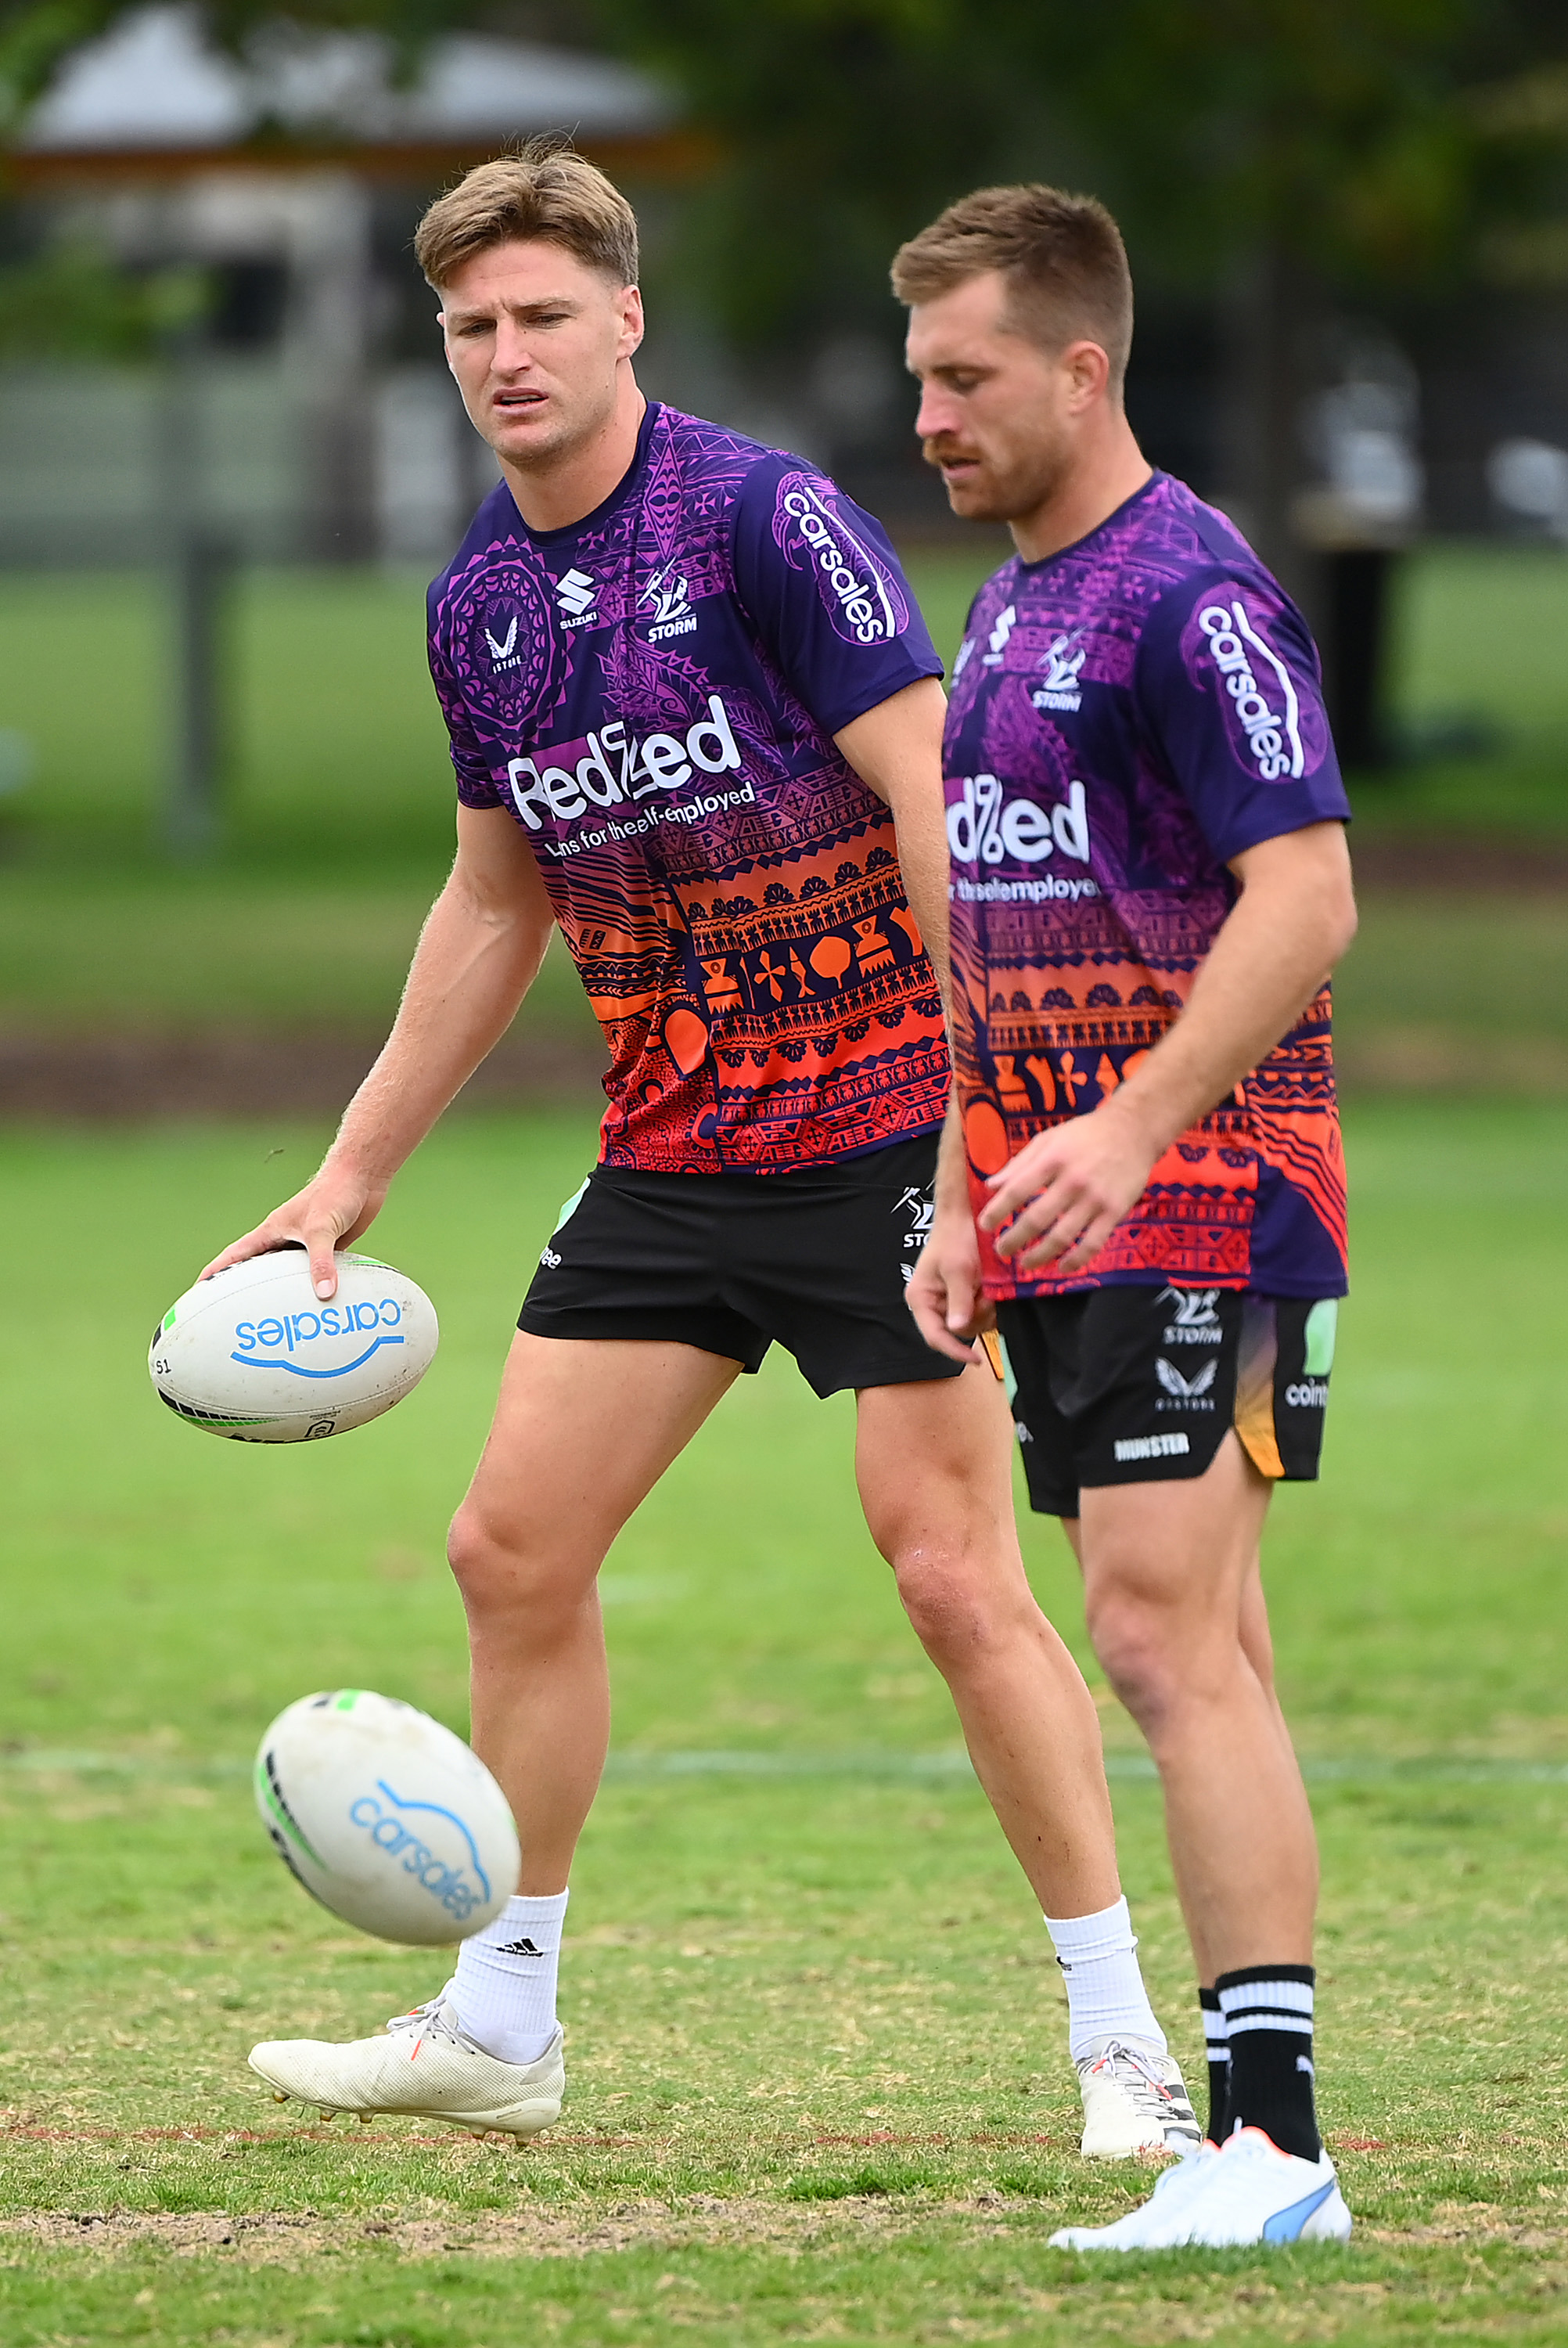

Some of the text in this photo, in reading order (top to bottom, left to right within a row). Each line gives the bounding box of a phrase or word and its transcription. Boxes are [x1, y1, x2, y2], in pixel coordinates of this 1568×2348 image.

[783, 492, 883, 643] carsales
[559, 611, 598, 630] SUZUKI
[648, 617, 697, 643] STORM
[1032, 690, 1082, 712] STORM
[1198, 605, 1291, 780] carsales
[507, 694, 742, 830] RedZed
[580, 828, 609, 849] for
[236, 1298, 401, 1352] carsales
[1163, 1325, 1223, 1345] STORM
